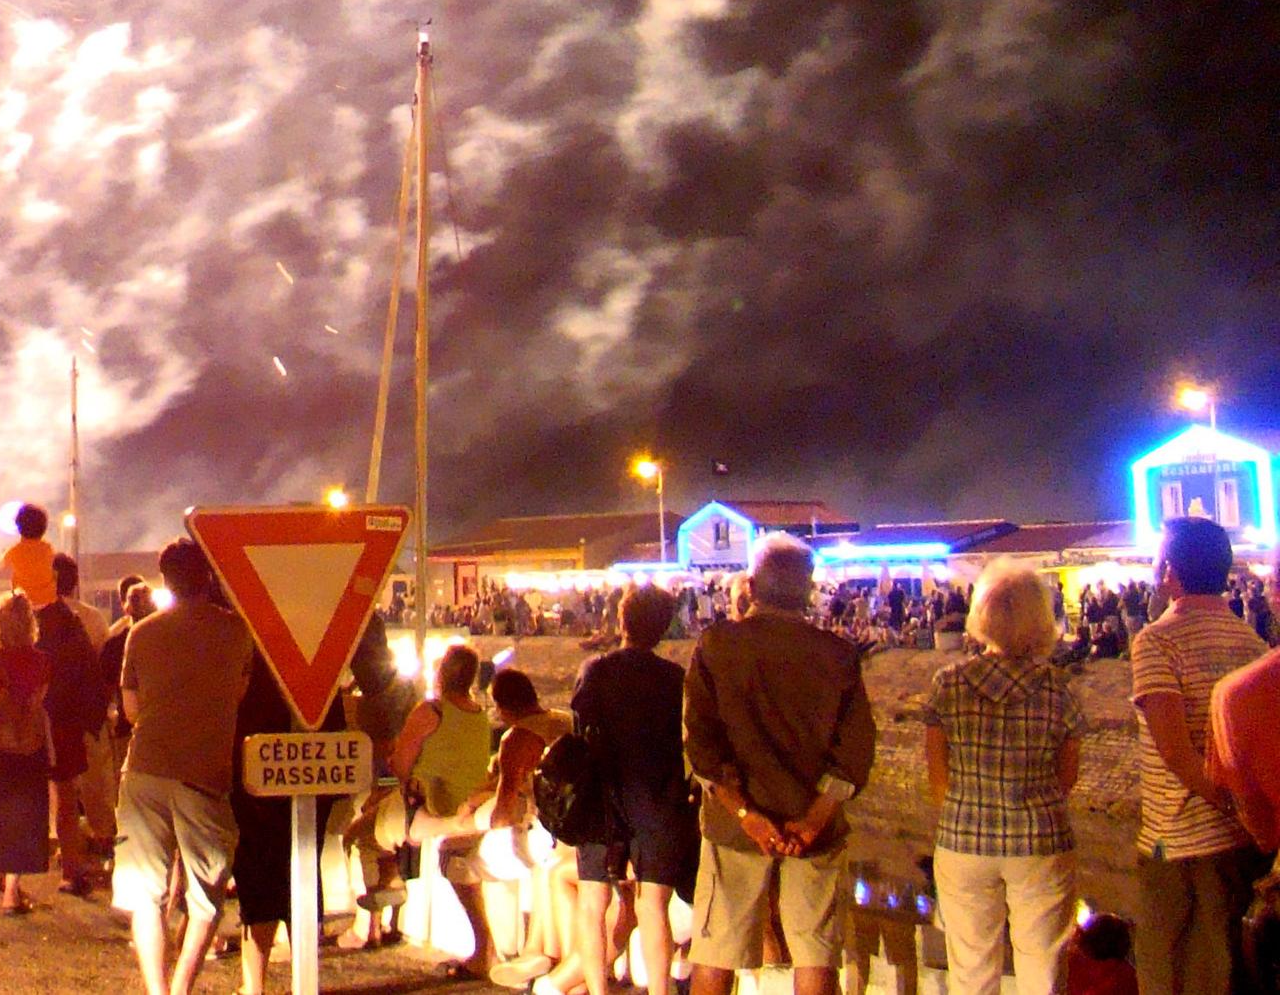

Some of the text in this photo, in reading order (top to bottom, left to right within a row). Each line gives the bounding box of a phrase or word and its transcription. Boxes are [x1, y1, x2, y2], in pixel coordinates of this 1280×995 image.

[259, 738, 360, 761] CÉDEZ LE
[263, 765, 356, 785] PASSAGE
